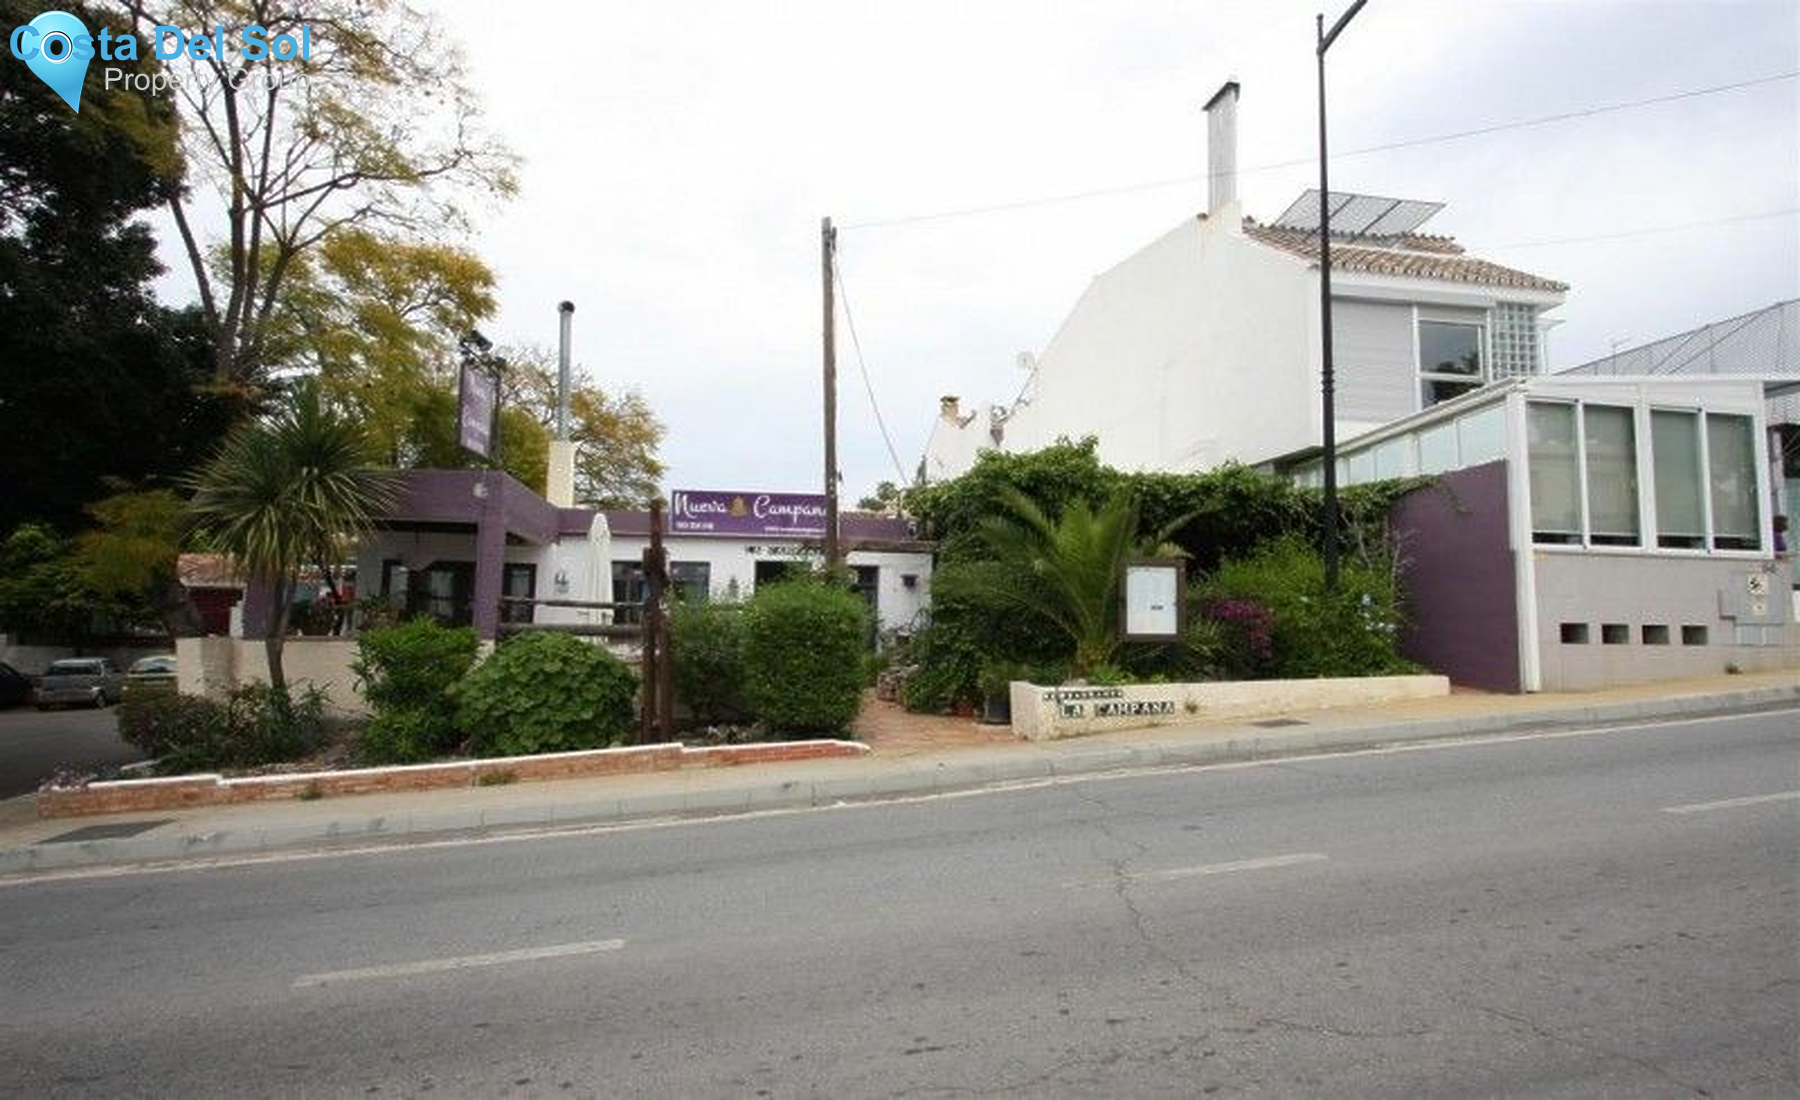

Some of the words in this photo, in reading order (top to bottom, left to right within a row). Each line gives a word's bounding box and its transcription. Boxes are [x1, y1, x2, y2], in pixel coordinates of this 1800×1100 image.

[674, 492, 728, 519] Nueva
[753, 494, 827, 524] Campan
[1061, 703, 1083, 717] LA
[1095, 700, 1175, 716] CAMPANA
